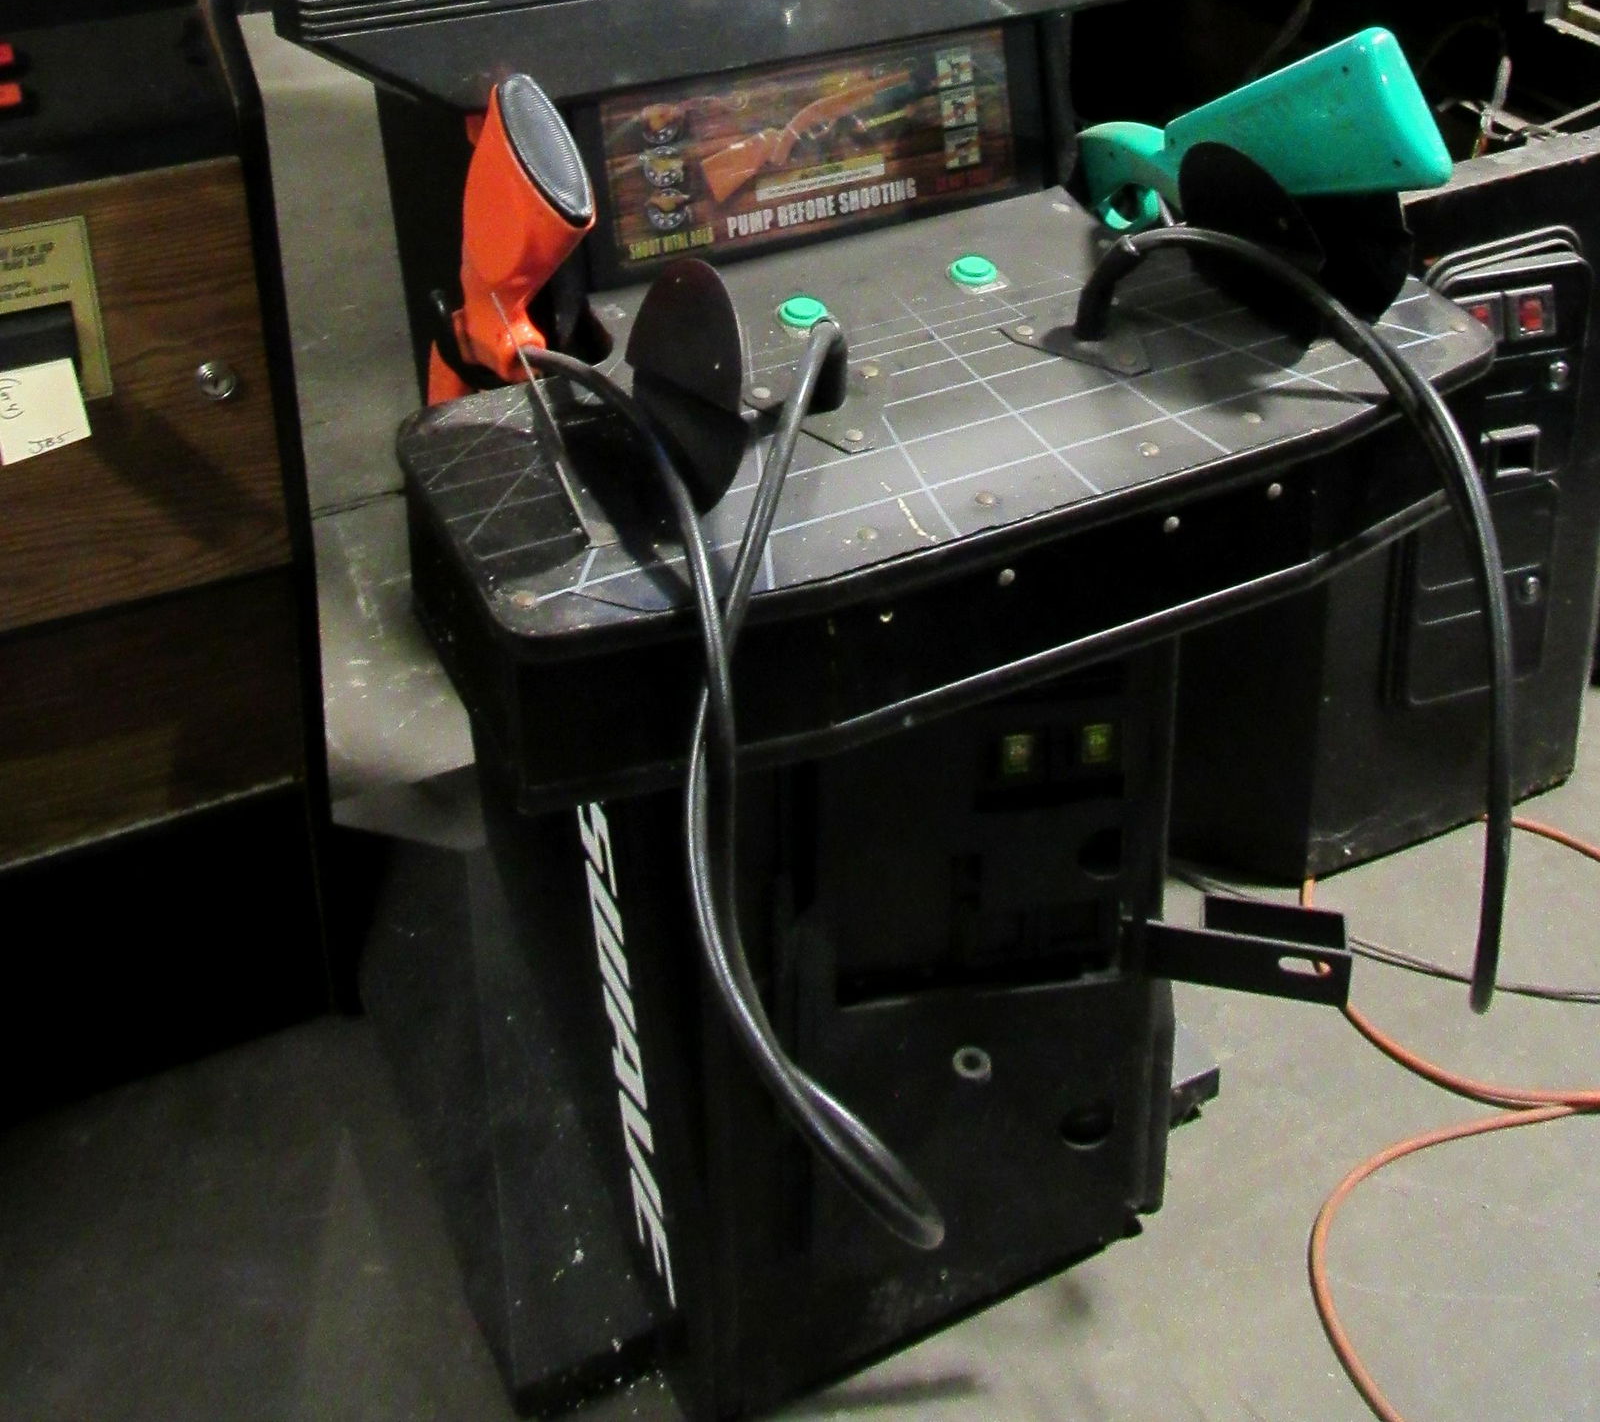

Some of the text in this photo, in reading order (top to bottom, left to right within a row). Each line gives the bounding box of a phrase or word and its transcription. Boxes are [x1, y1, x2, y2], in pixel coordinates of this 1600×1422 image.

[727, 208, 773, 239] PUMP
[777, 195, 837, 227] BEFORE
[838, 177, 917, 215] SHOOTING
